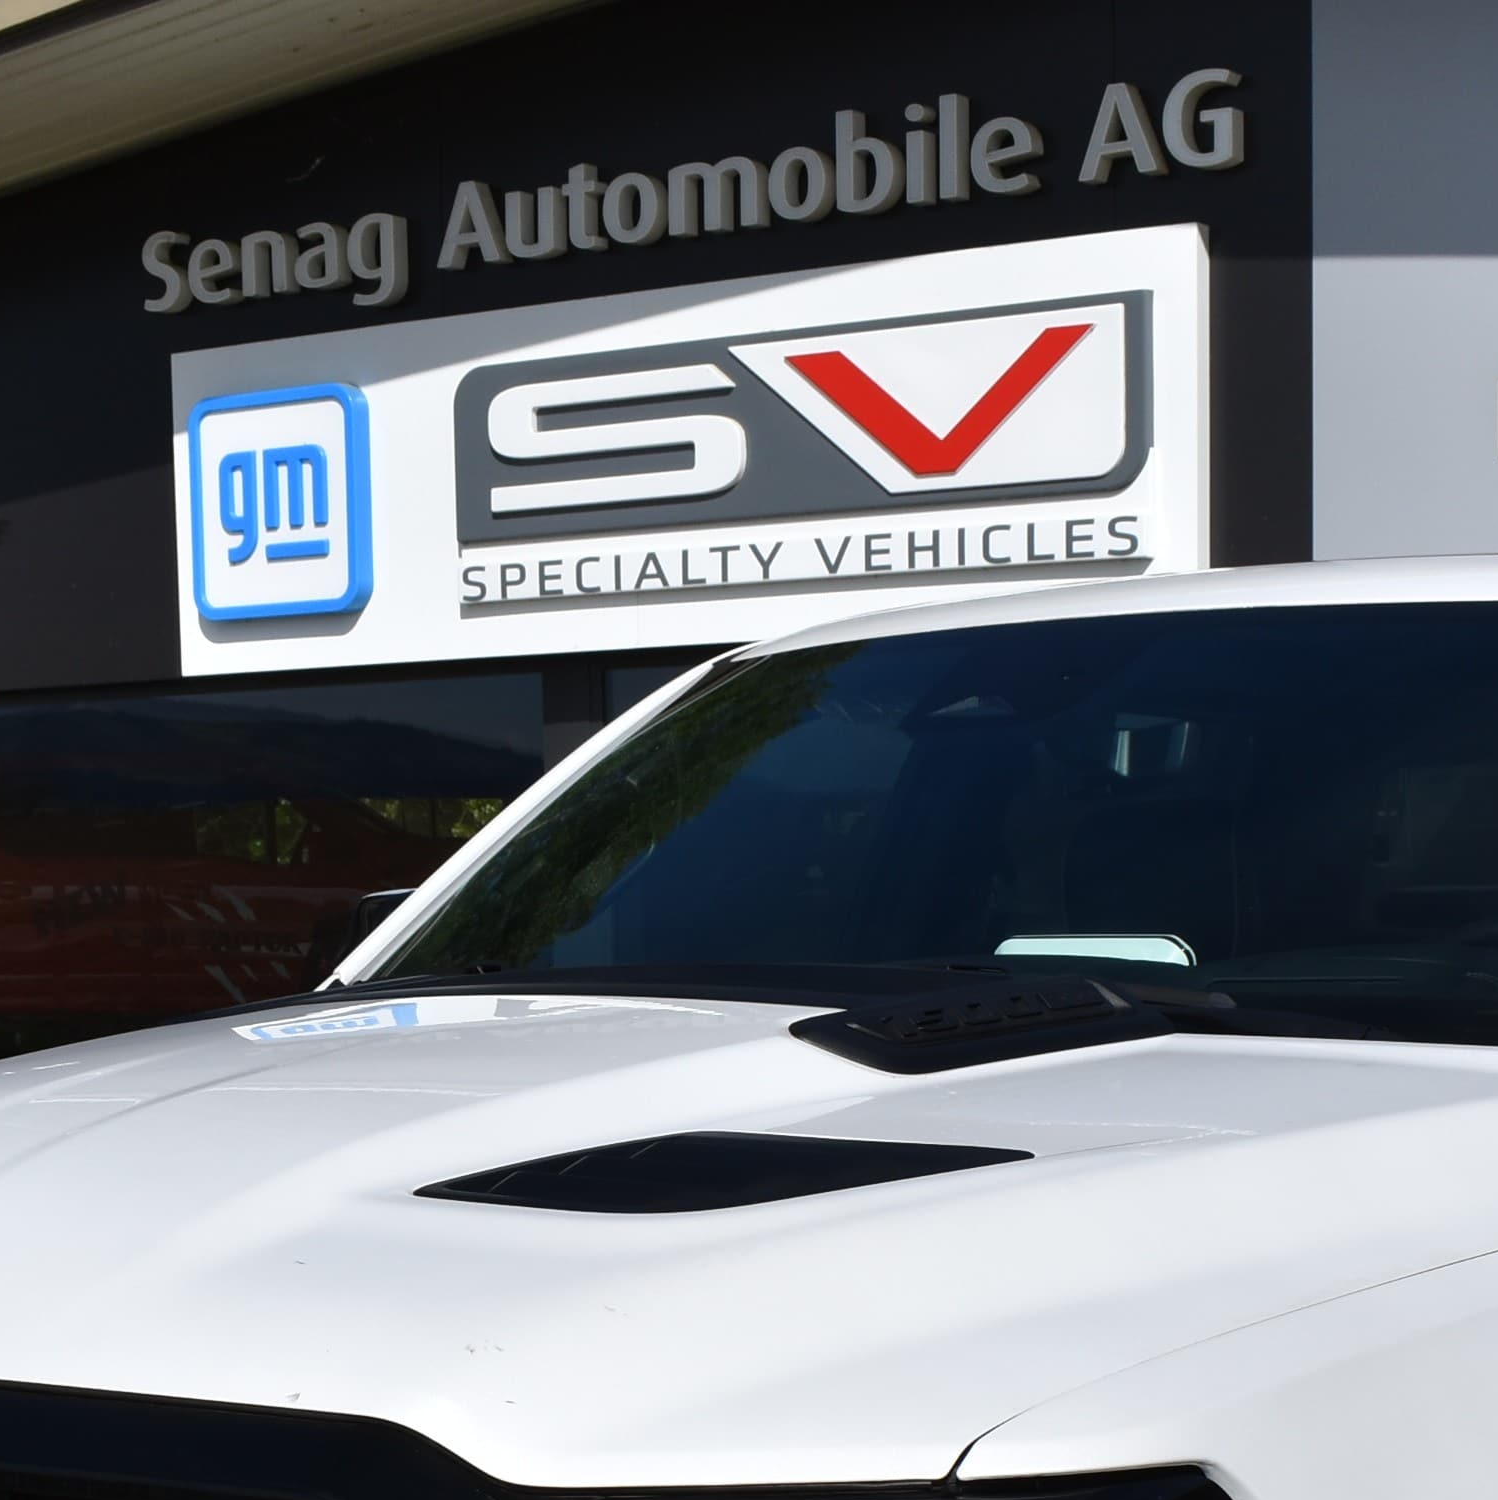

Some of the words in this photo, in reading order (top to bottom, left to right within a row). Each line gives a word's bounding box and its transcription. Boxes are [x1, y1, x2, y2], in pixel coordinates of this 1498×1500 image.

[141, 211, 408, 313] Senag
[437, 93, 1044, 270] Automobile
[1078, 68, 1247, 186] AG
[489, 323, 1095, 514] SV
[219, 443, 329, 566] gm
[460, 540, 785, 602] SPECIALTY
[814, 514, 1142, 576] VEHICLES
